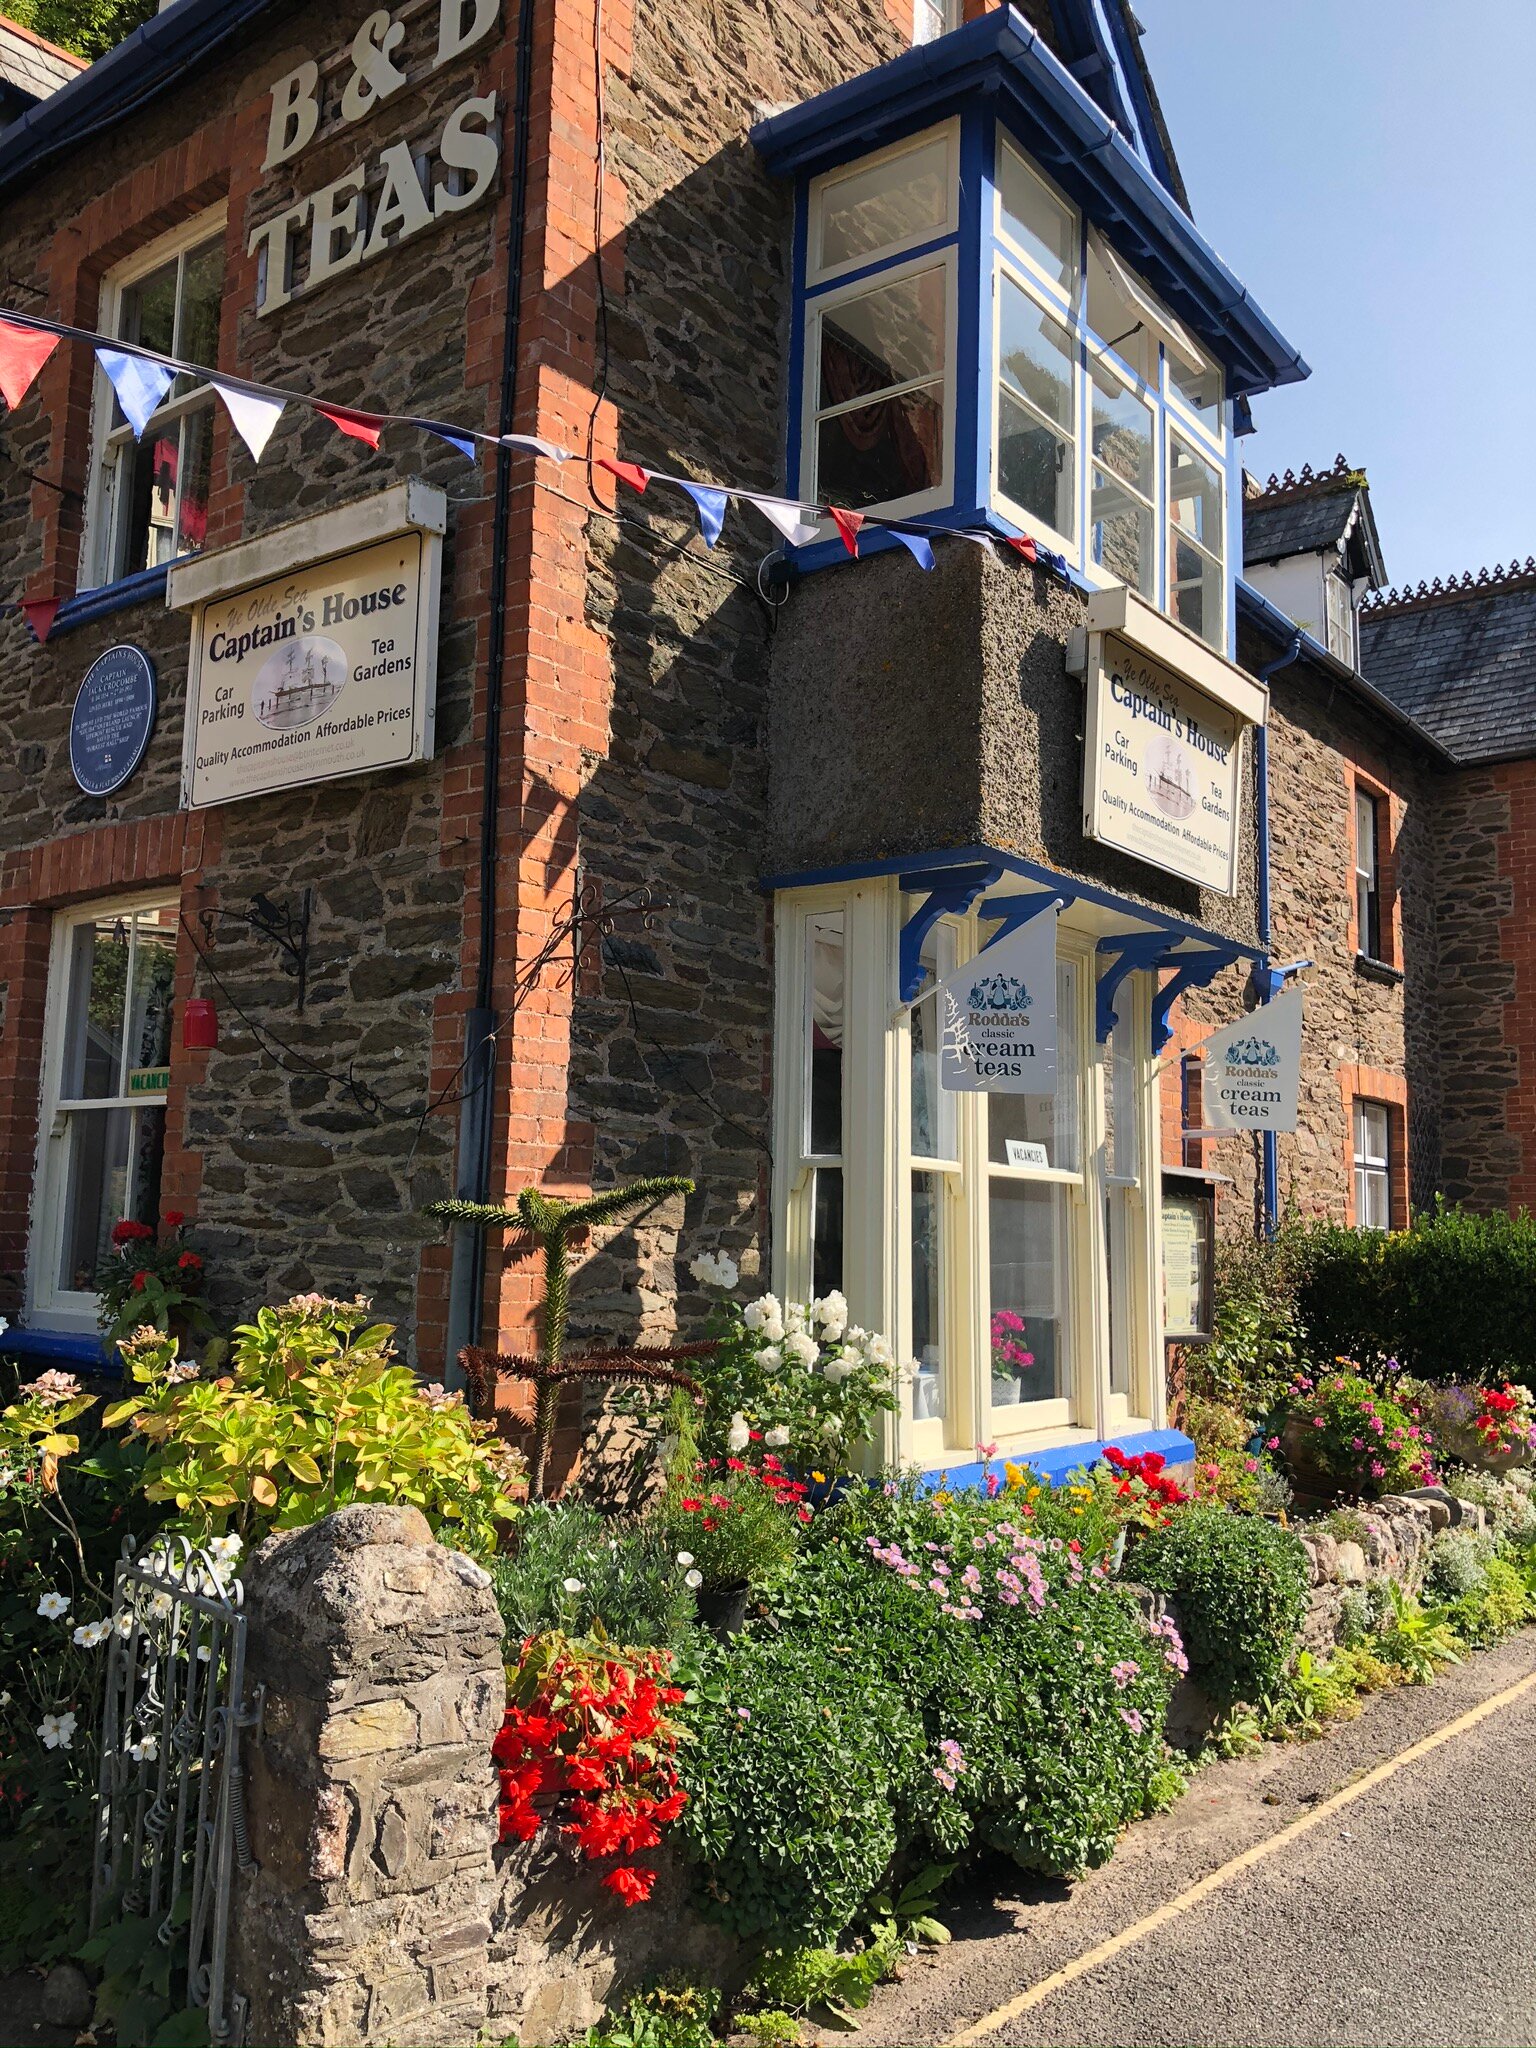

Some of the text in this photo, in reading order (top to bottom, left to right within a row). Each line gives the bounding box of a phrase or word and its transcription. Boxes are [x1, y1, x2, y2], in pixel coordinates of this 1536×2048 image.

[260, 60, 319, 173] B
[342, 9, 407, 122] &
[247, 89, 499, 320] TEAS
[226, 585, 309, 631] Ye Olde Sea
[209, 583, 408, 663] Captain's House
[372, 637, 395, 656] Tea
[353, 656, 412, 683] Gardens
[1122, 658, 1180, 708] Ye Olde Sea
[214, 685, 234, 702] Car
[201, 699, 245, 726] Parking
[1110, 673, 1228, 766] Captain's House
[196, 705, 412, 770] Quality Accommodation Affordable Prices
[1115, 730, 1130, 749] Car
[1105, 742, 1138, 777] Parking
[1211, 781, 1223, 798] Tea
[1202, 796, 1230, 822] Gardens
[1102, 789, 1128, 815] Quality
[1129, 802, 1181, 837] Accommodation
[1182, 828, 1213, 854] Affordable
[1213, 843, 1229, 862] Prices
[967, 1012, 1030, 1027] Rodda's
[981, 1029, 1015, 1039] classic
[964, 1041, 1036, 1057] cream
[975, 1057, 1022, 1077] teas
[1224, 1065, 1278, 1079] Rodda's
[1236, 1079, 1265, 1088] classic
[1220, 1087, 1282, 1104] cream
[1229, 1102, 1269, 1118] teas
[1012, 1147, 1043, 1163] VACANCIES
[1161, 1212, 1179, 1221] aptain's
